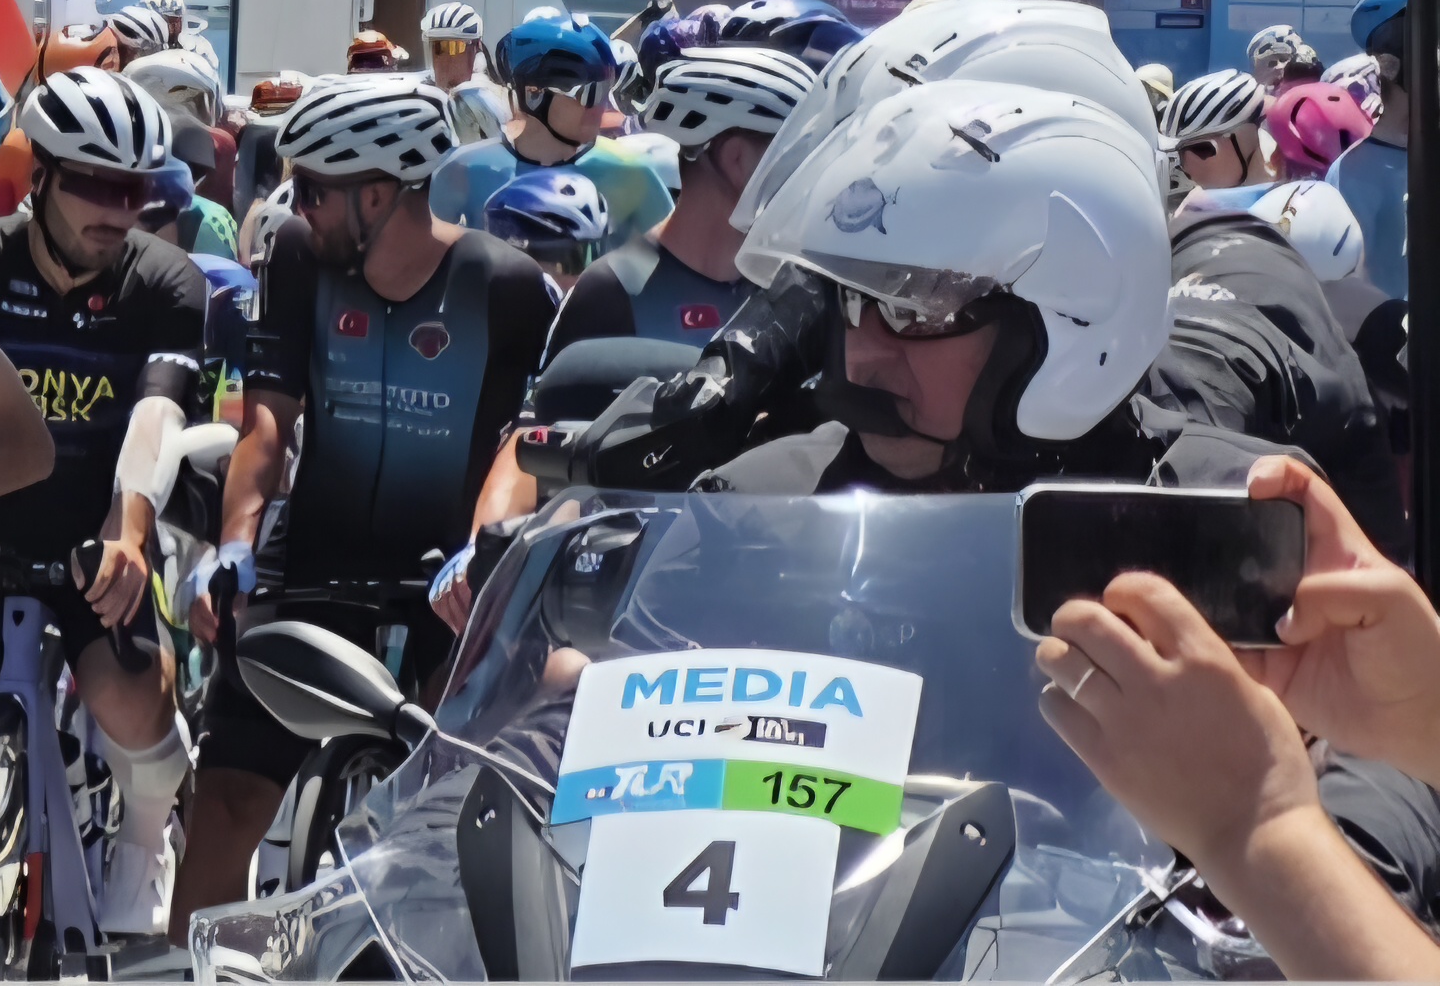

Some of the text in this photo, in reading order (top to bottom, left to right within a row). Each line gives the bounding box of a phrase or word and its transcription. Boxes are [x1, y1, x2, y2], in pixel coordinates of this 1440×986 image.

[620, 667, 864, 718] MEDIA
[647, 718, 706, 738] UCI
[762, 770, 852, 814] 157
[662, 840, 740, 925] 4
